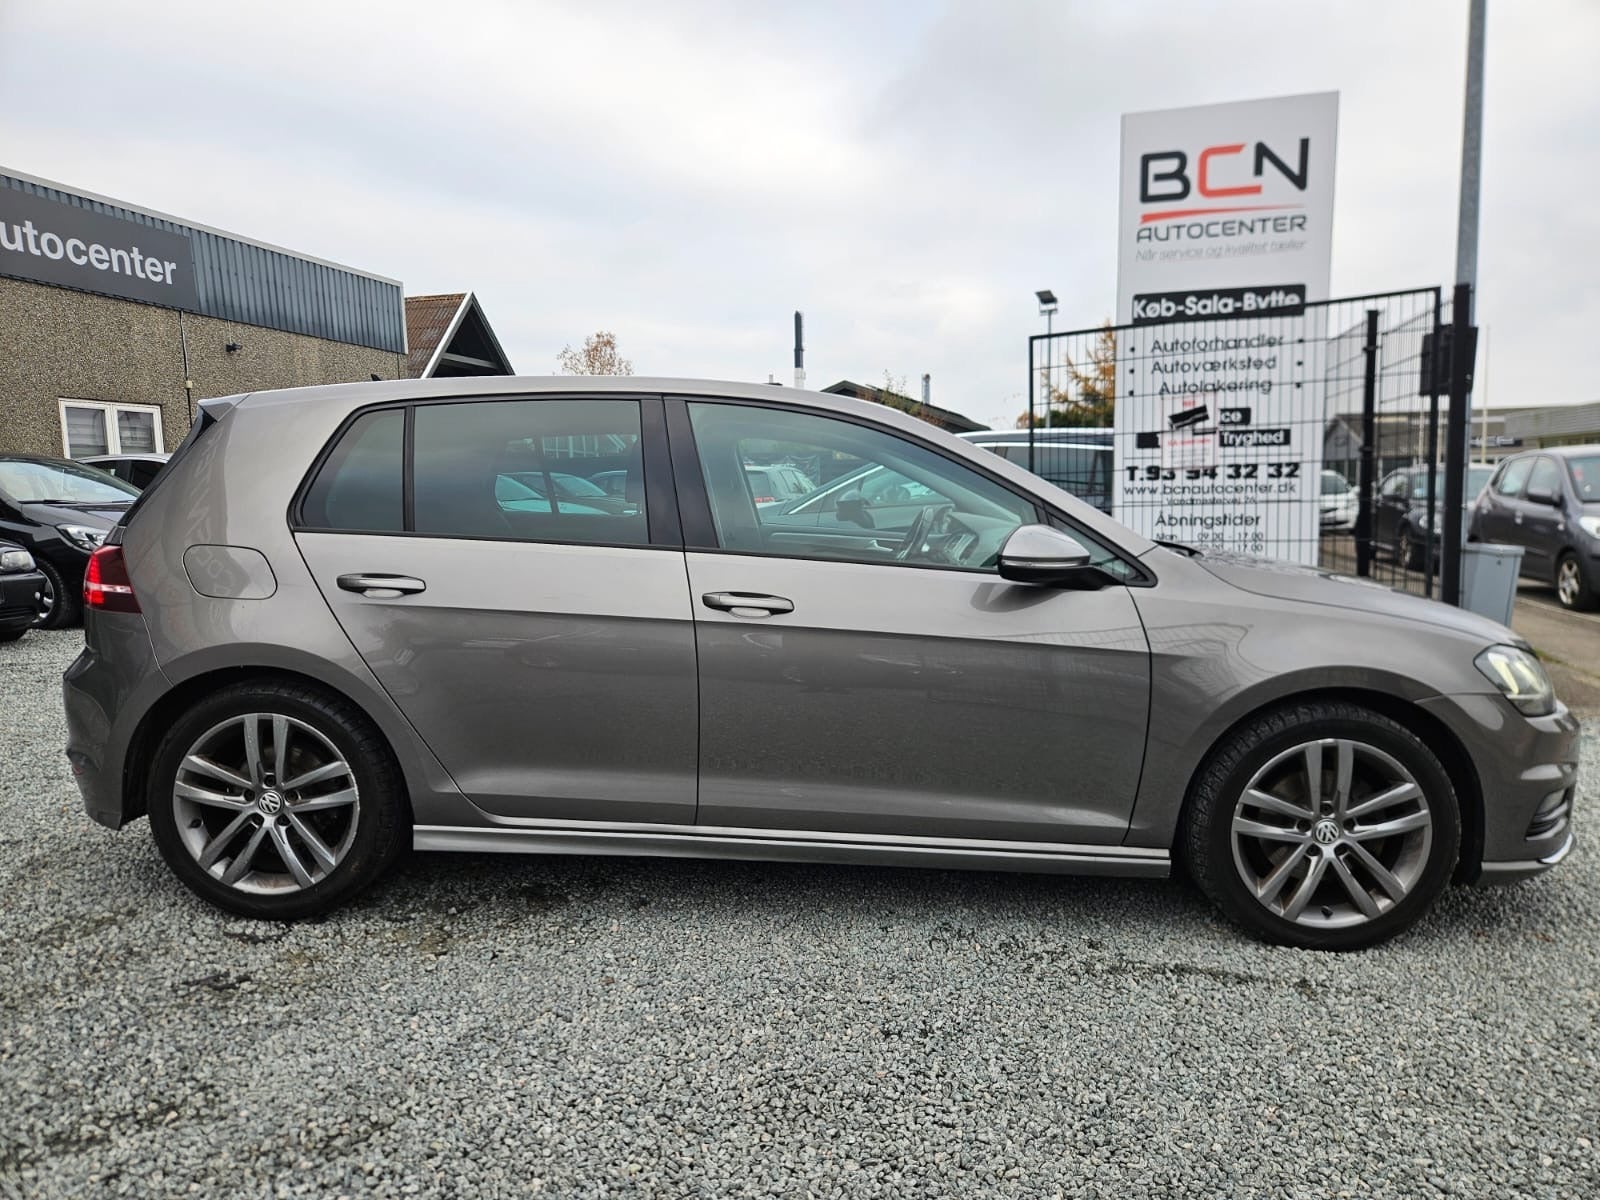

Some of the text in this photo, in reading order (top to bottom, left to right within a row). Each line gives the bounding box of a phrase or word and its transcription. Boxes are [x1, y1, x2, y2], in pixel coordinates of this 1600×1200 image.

[1140, 137, 1310, 204] BCN
[1136, 214, 1308, 243] AUTOCENTER
[0, 220, 177, 285] utocenter
[1150, 333, 1284, 353] Autoforhandler
[1151, 356, 1277, 375] Autoværksted
[1158, 377, 1273, 395] Autolakering
[1222, 429, 1284, 448] Tryghed
[1227, 464, 1259, 480] 32
[1266, 463, 1300, 478] 32
[1155, 511, 1261, 529] Åbningstider
